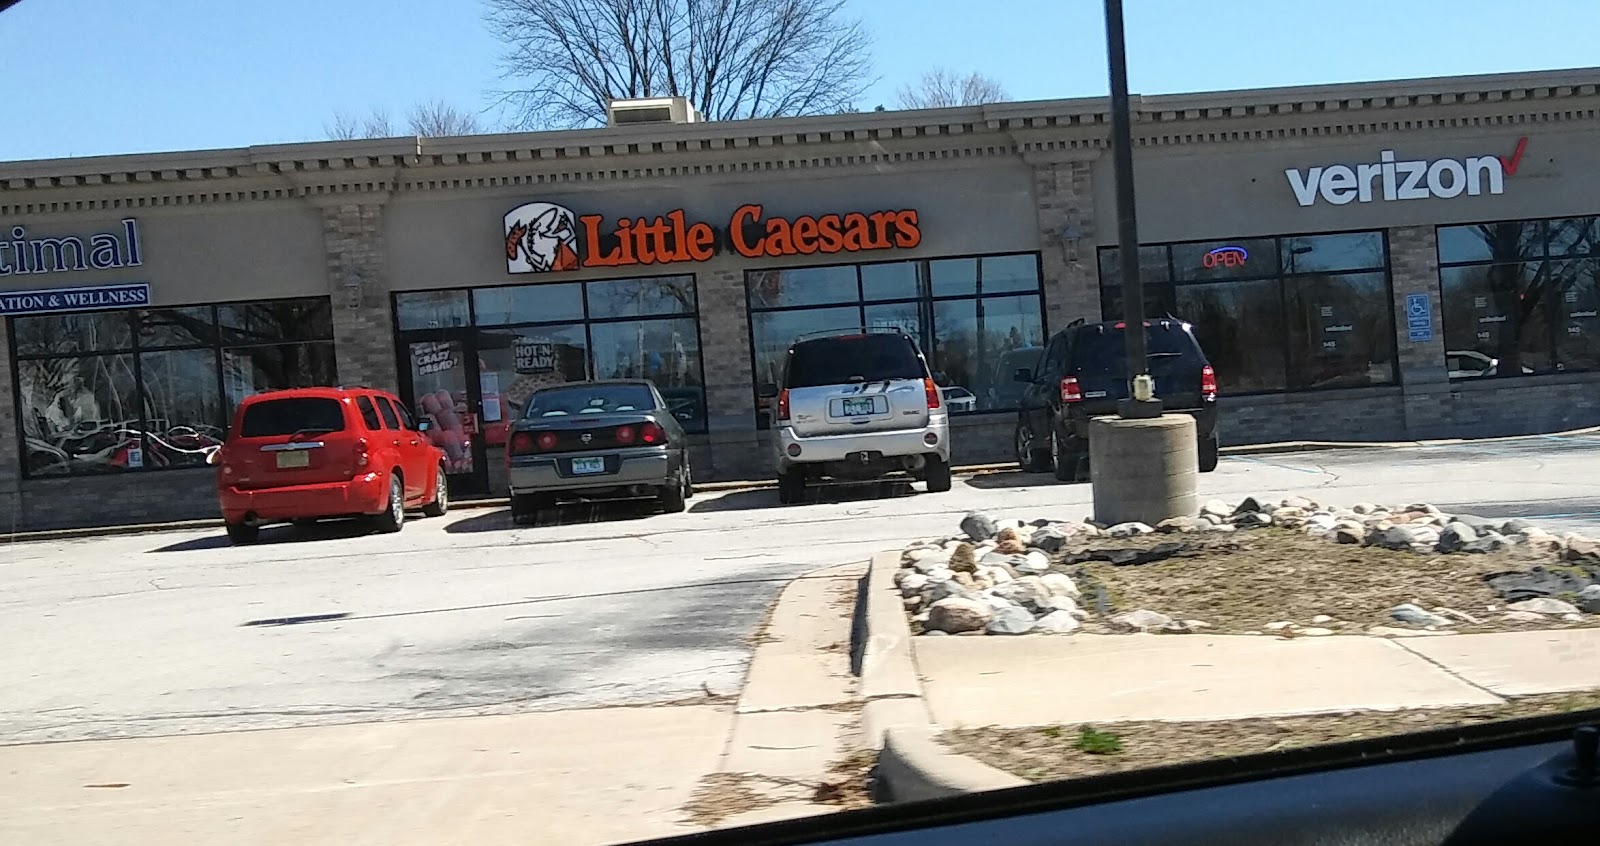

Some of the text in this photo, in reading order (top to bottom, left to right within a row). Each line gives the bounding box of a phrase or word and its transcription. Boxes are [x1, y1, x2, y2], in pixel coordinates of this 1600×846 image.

[1285, 150, 1504, 207] verizon
[579, 204, 921, 268] Little Caesars
[1203, 251, 1246, 268] OPEN
[48, 294, 60, 308] &
[64, 289, 146, 306] WELLNESS
[417, 350, 450, 366] CRAZY
[419, 357, 458, 375] BREAD!
[516, 355, 554, 368] READY
